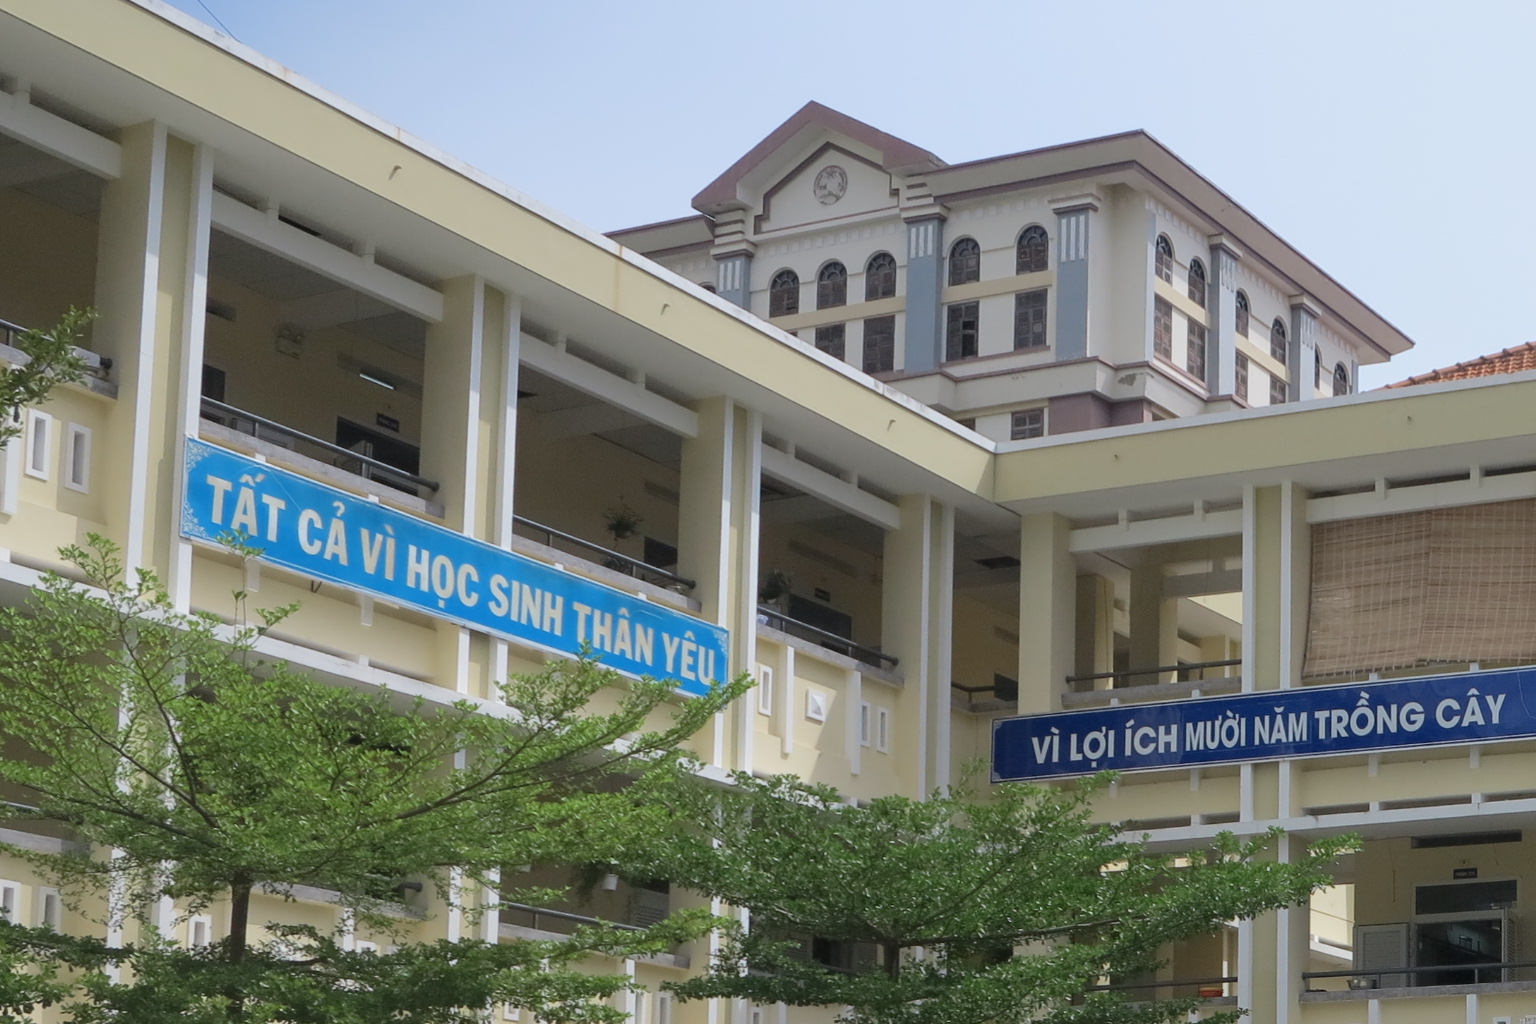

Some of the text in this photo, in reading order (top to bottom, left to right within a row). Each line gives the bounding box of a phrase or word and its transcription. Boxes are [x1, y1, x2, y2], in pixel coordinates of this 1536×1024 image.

[206, 473, 715, 687] TẤT CẢ VÌ HỌC SINH THÂN YÊU
[1031, 687, 1506, 768] VÌ LỢI ÍCH MƯỜI NĂM TRỒNG CÂY
